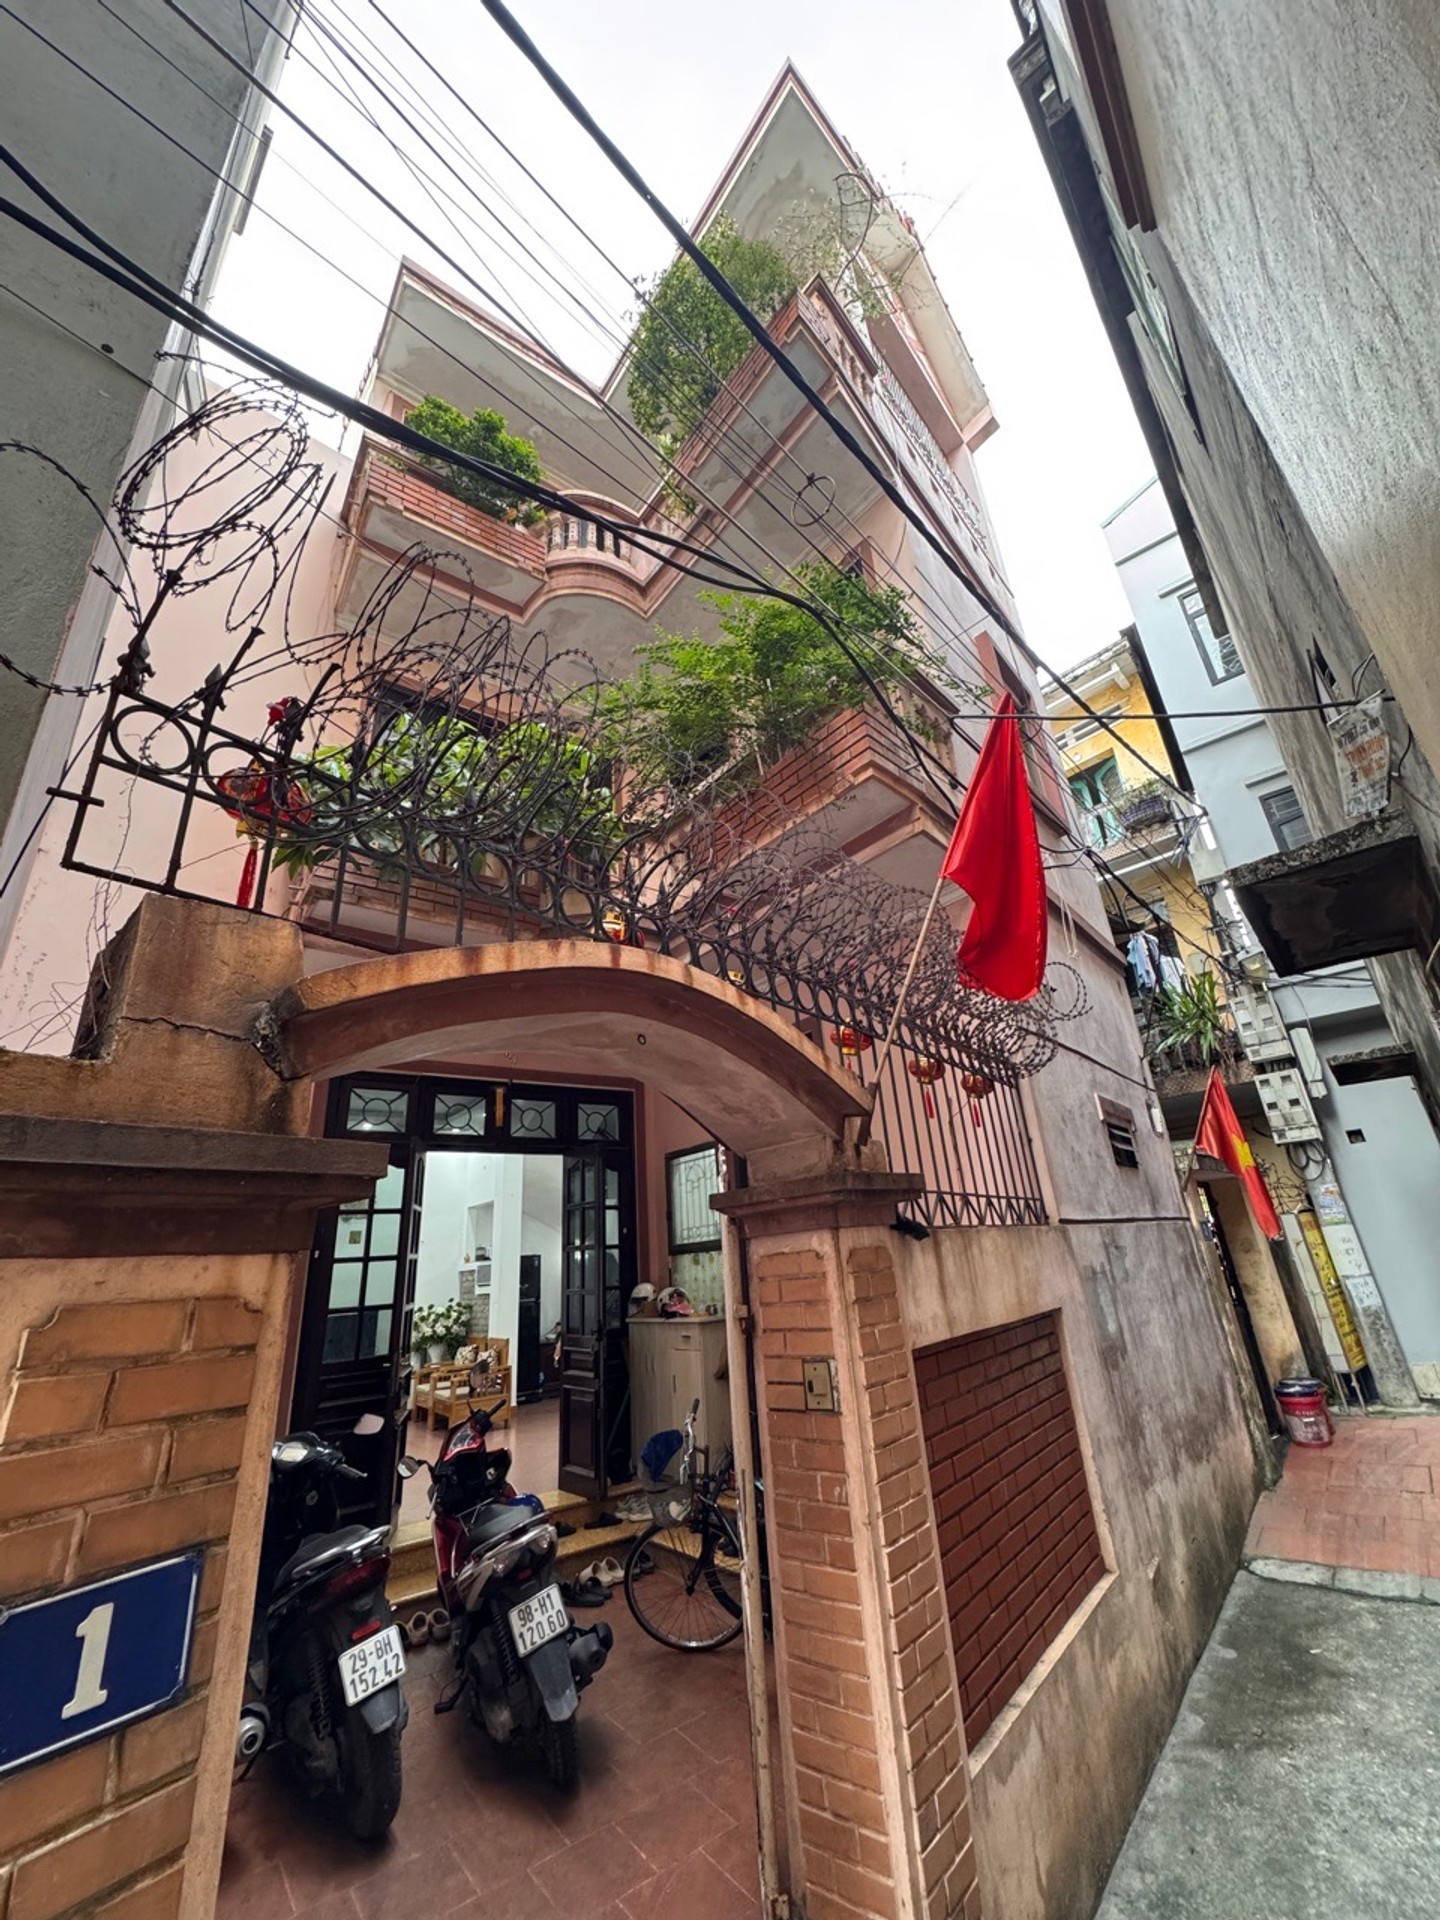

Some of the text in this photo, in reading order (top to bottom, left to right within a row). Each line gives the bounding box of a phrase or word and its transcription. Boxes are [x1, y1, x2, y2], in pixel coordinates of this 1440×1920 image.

[517, 1592, 555, 1628] 98-H1
[519, 1609, 566, 1650] 120.60
[61, 1602, 115, 1720] 1
[348, 1634, 393, 1674] 29-BH
[350, 1653, 403, 1698] 152.42
